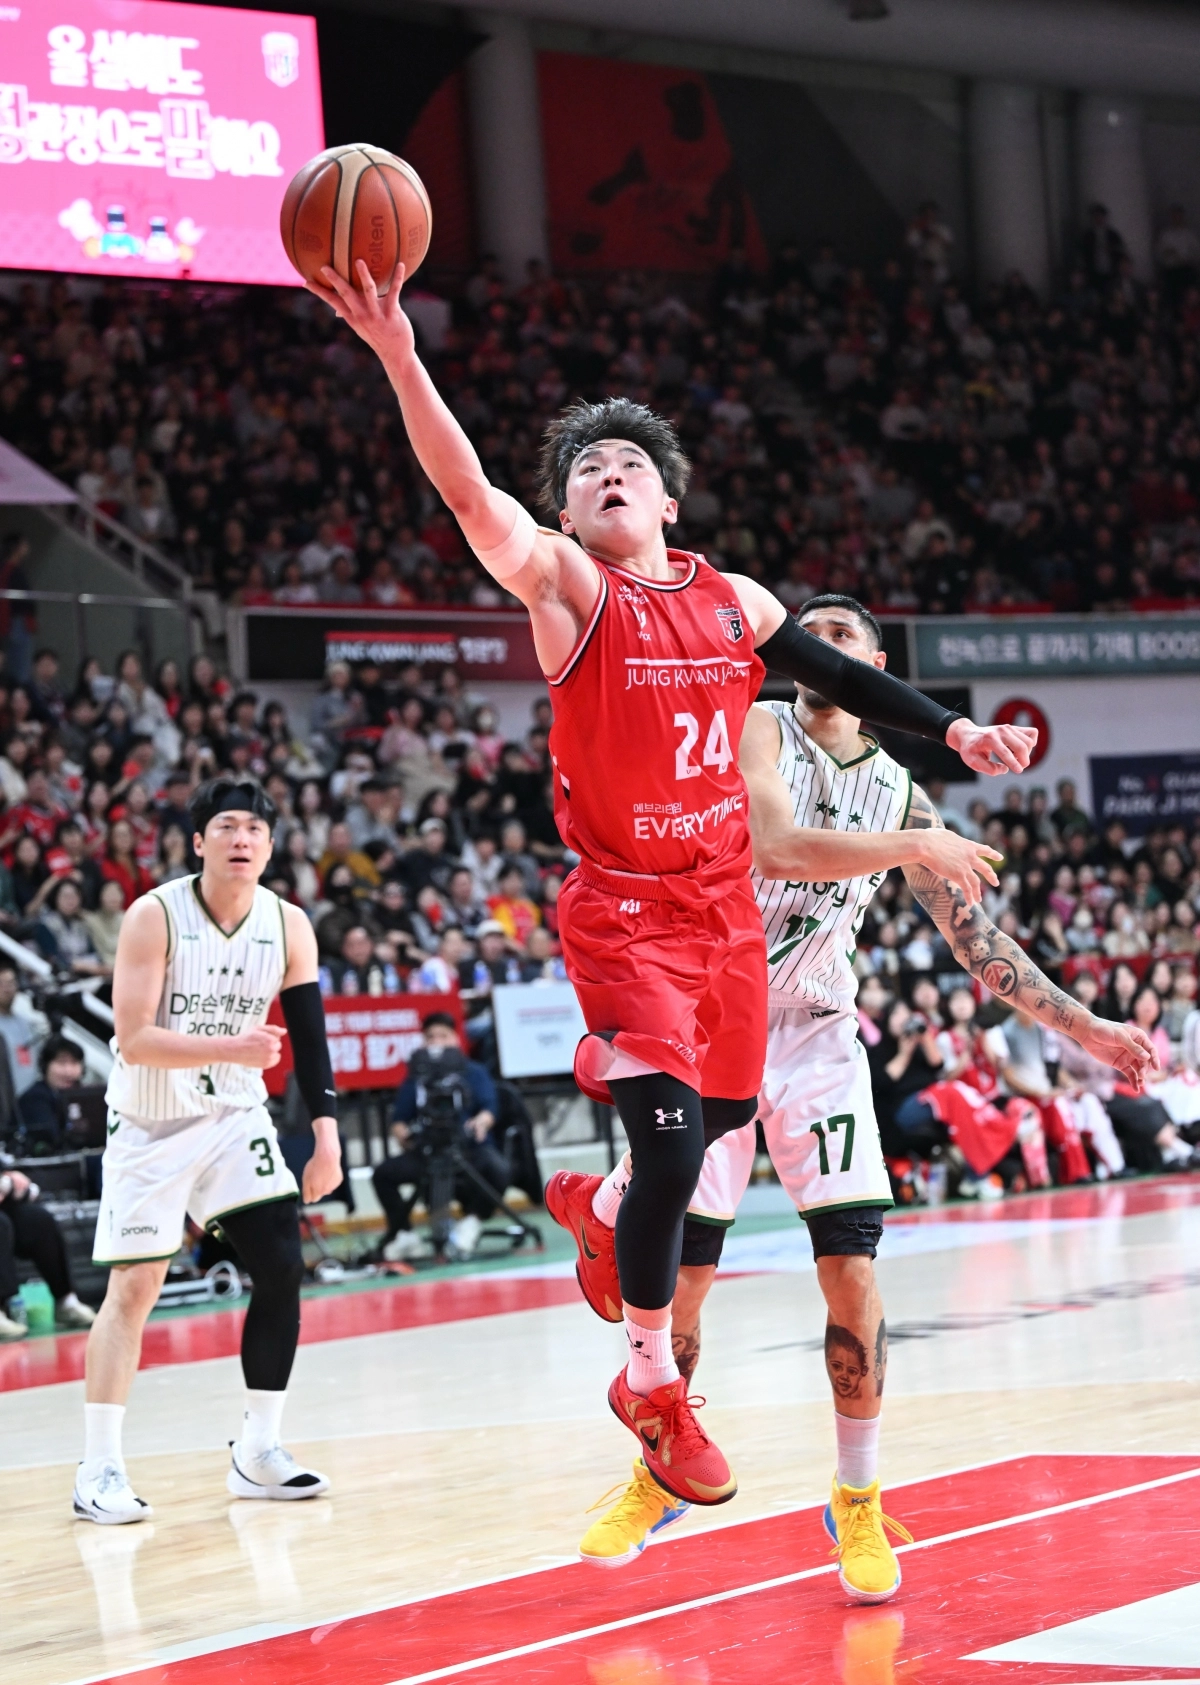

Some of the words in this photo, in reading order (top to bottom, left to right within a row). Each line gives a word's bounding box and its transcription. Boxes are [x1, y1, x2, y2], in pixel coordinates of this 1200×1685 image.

[47, 25, 88, 87] 올
[625, 667, 671, 690] JUNG
[673, 667, 719, 689] KWAN
[673, 709, 734, 780] 24
[633, 802, 682, 815] 에브리타임
[170, 992, 268, 1016] DB손해보험
[250, 1137, 275, 1177] 3
[809, 1113, 855, 1176] 17
[121, 1225, 158, 1238] promy
